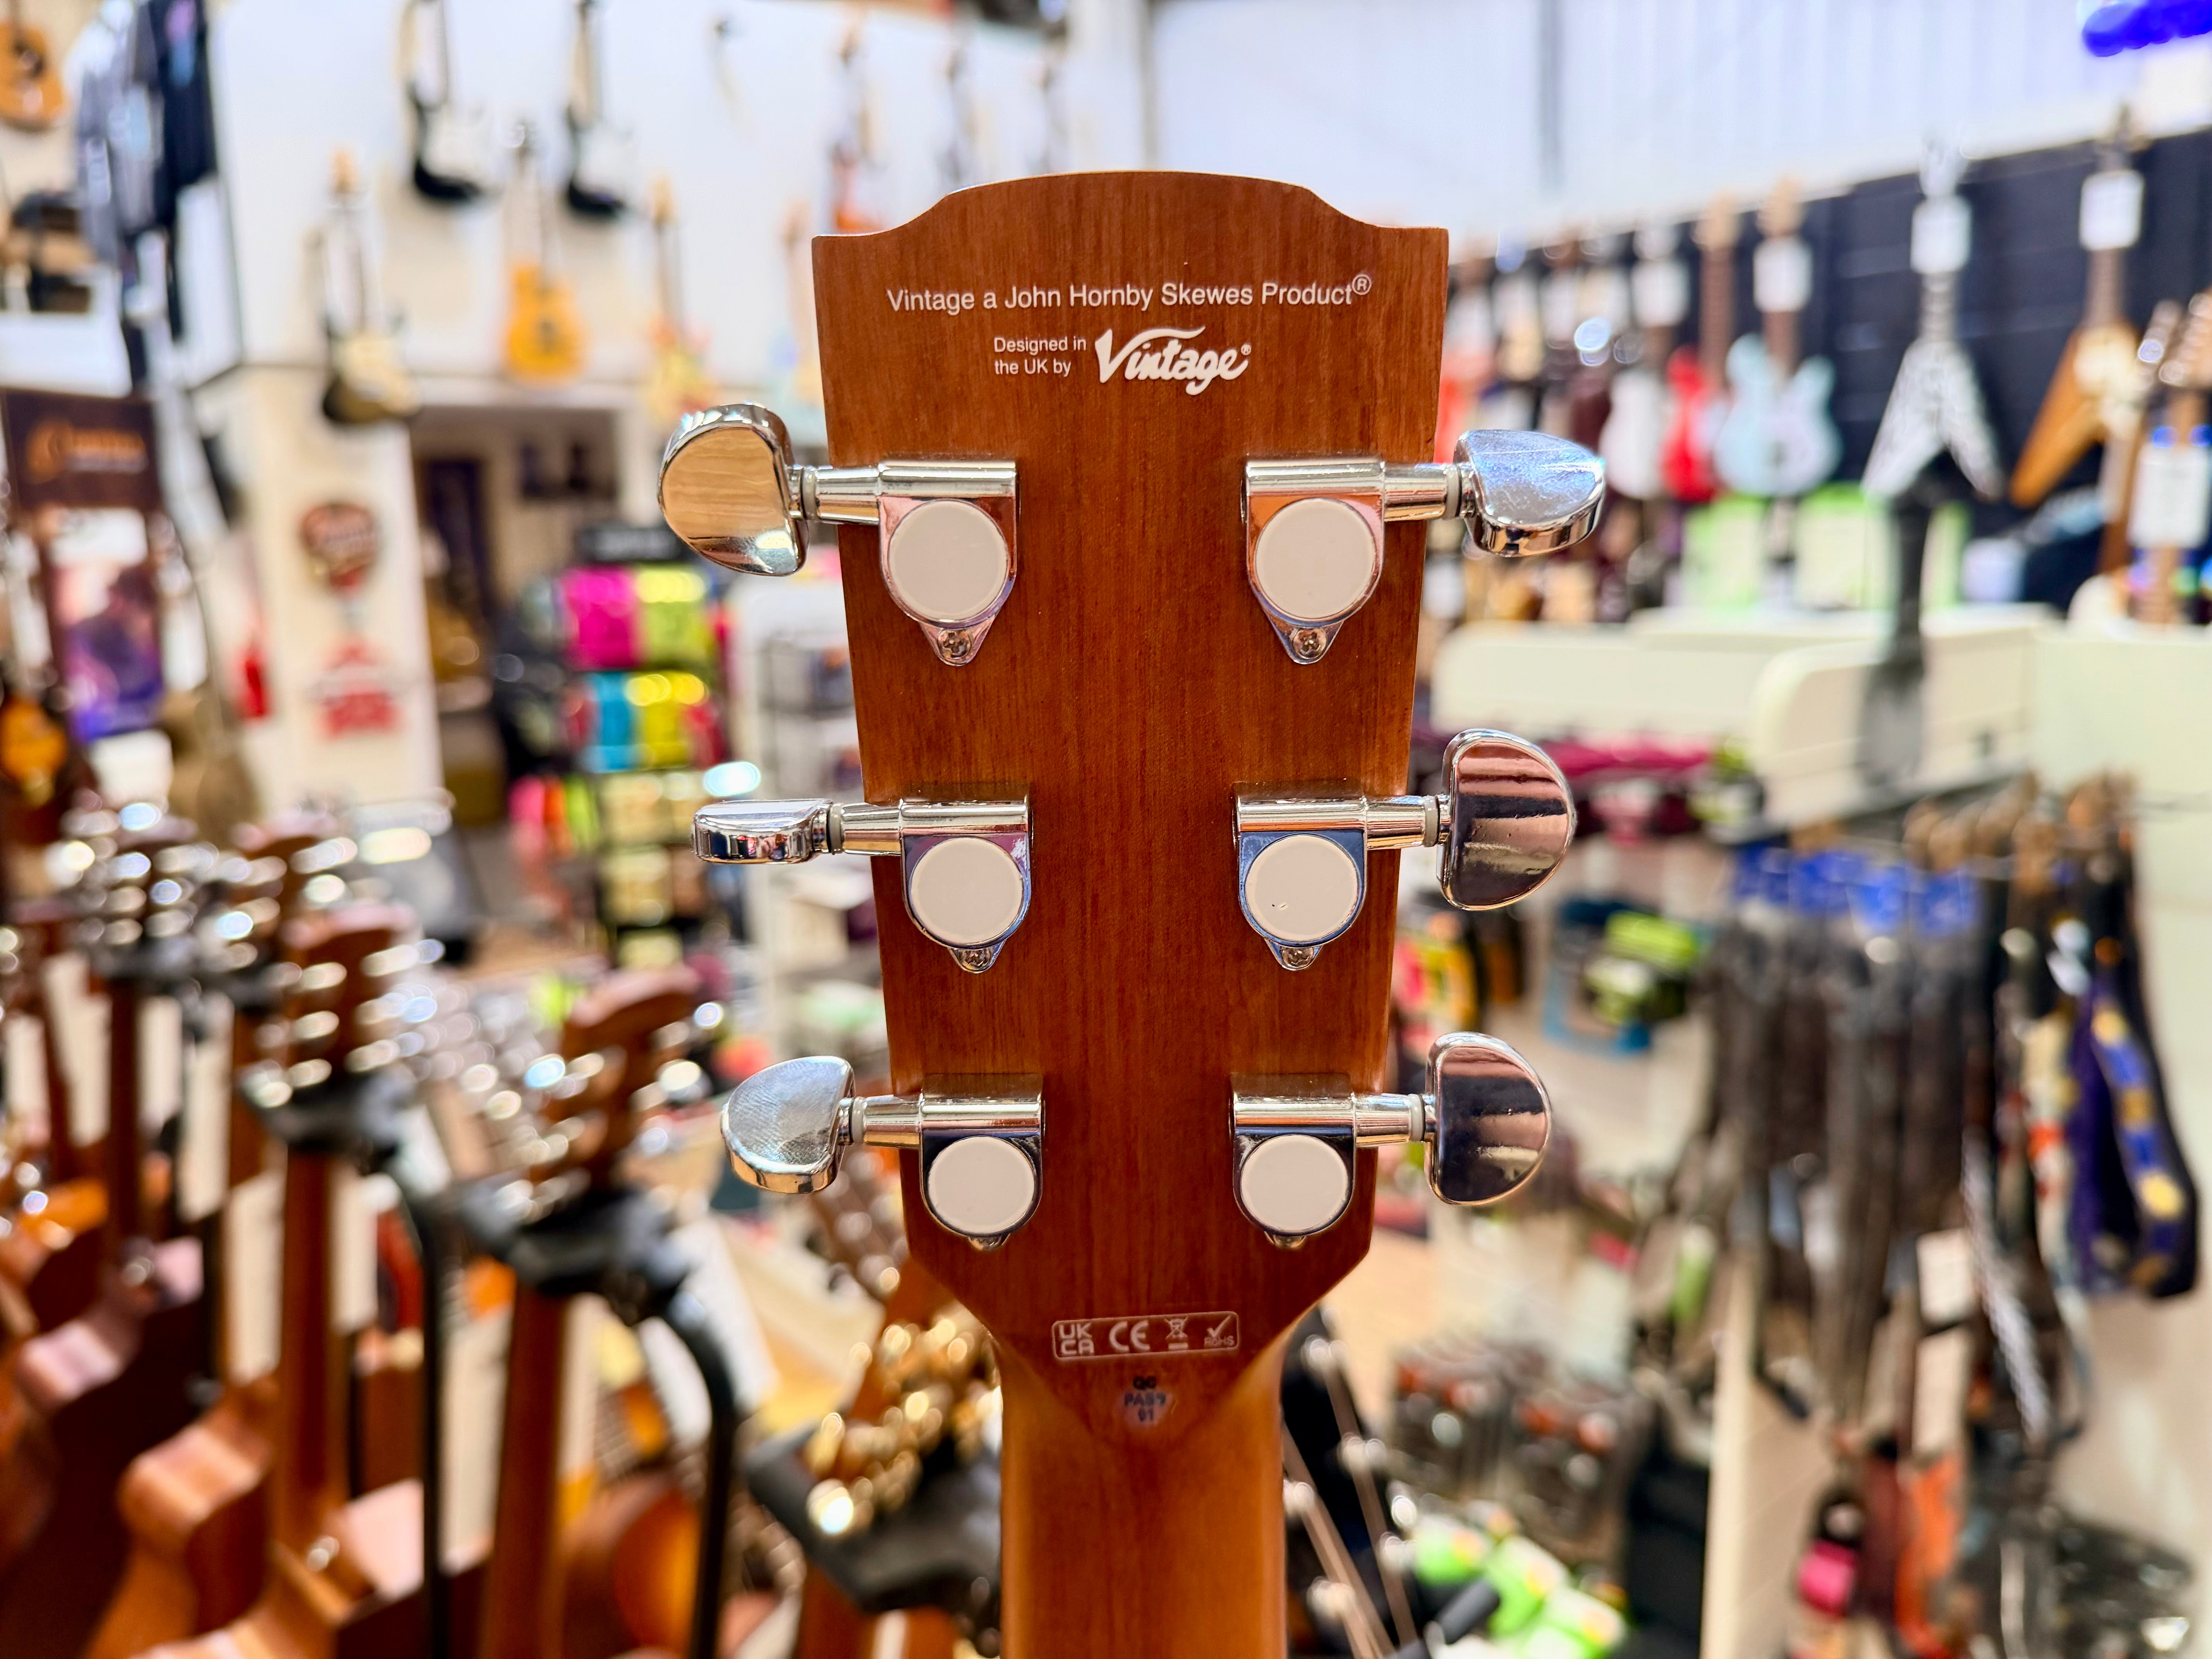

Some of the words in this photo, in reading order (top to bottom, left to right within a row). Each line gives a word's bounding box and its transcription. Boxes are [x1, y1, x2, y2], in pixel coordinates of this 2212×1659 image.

[887, 289, 974, 315] Vintage
[983, 292, 998, 309] a
[1005, 285, 1061, 309] John
[1070, 283, 1153, 311] Hornby
[1162, 283, 1252, 306] Skewes
[994, 336, 1068, 355] Designed
[1073, 337, 1086, 351] in
[994, 359, 1018, 374] the
[1024, 359, 1048, 374] UK
[1053, 358, 1072, 377] by
[1059, 1322, 1092, 1339] UK
[1109, 1319, 1150, 1353] CE
[1061, 1339, 1095, 1355] CA
